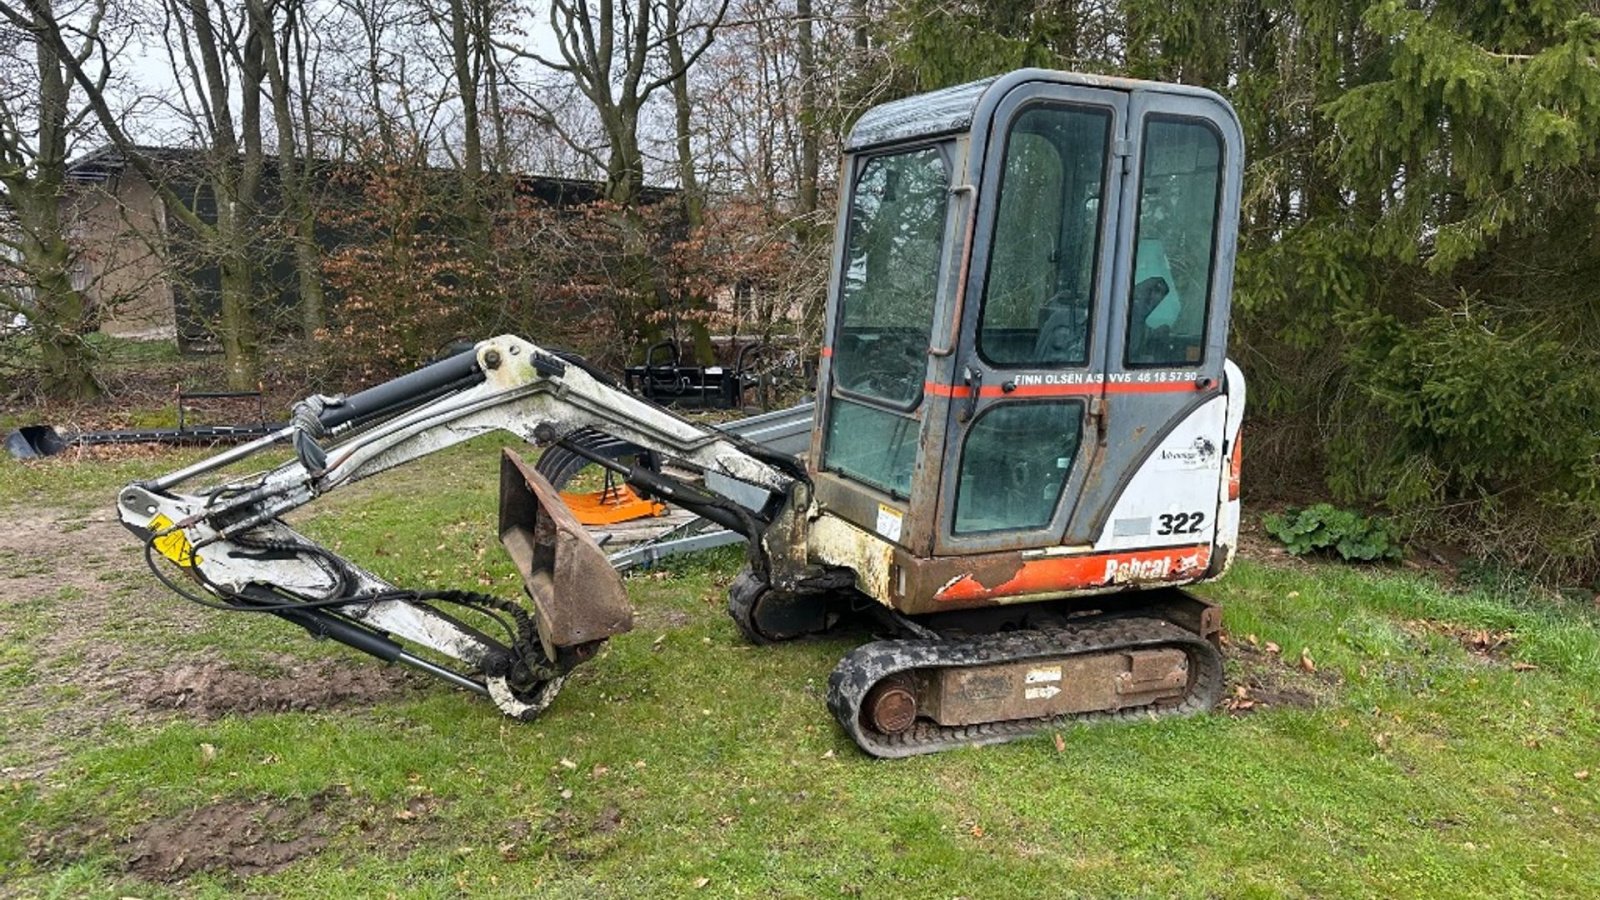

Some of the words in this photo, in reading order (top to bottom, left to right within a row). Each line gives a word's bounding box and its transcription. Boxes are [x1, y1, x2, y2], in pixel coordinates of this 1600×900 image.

[1014, 374, 1042, 386] FINN
[1045, 373, 1084, 385] OLSEN
[1137, 372, 1151, 382] 46
[1154, 371, 1167, 382] 18
[1169, 371, 1182, 381] 57
[1184, 371, 1198, 381] 90
[1156, 511, 1205, 535] 322
[1103, 556, 1172, 583] Bobcat
